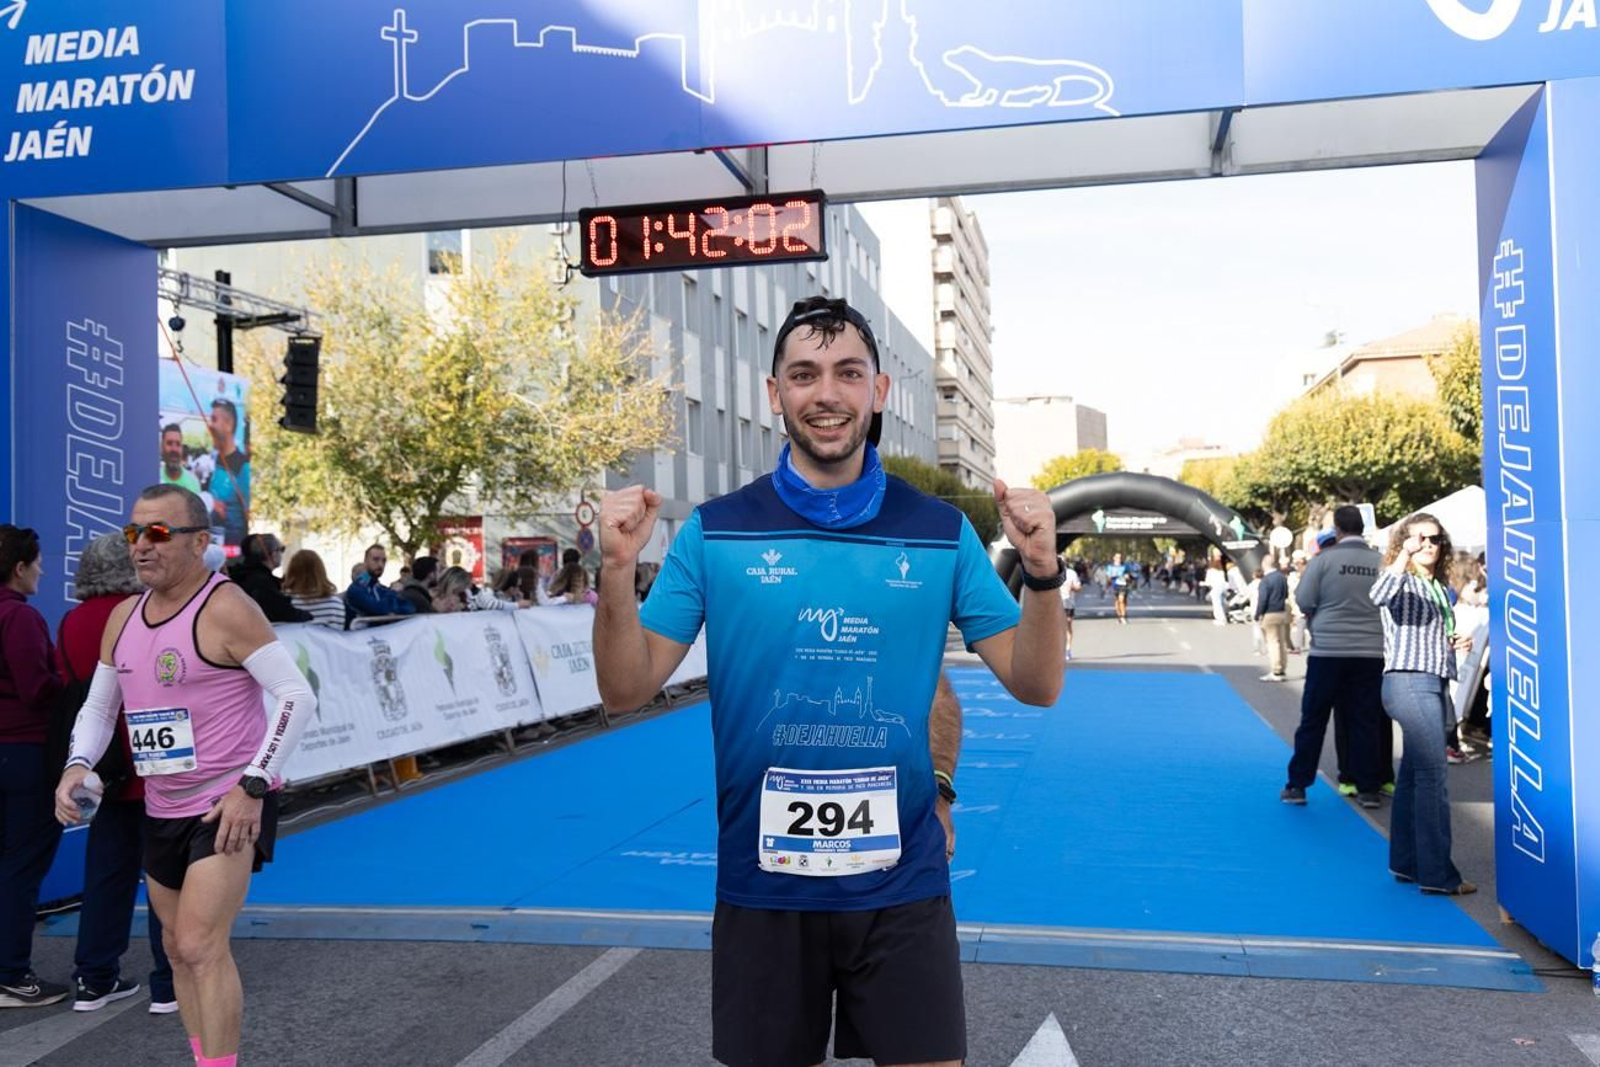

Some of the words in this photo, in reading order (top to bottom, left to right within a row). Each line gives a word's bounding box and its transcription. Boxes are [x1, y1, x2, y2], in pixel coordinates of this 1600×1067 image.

[25, 26, 140, 65] MEDIA
[17, 64, 195, 114] MARATÓN
[4, 121, 93, 162] JAÉN
[589, 200, 811, 266] 01:42:02
[1493, 238, 1545, 864] #DEJAHUELLA
[768, 567, 798, 576] RURAL
[840, 625, 879, 634] MARATÓN
[843, 617, 868, 625] MEDIA
[837, 633, 857, 643] JAÉN
[132, 726, 175, 751] 446
[772, 724, 888, 748] #DEJAHUELLA
[787, 799, 874, 837] 294
[812, 840, 851, 849] MARCOS
